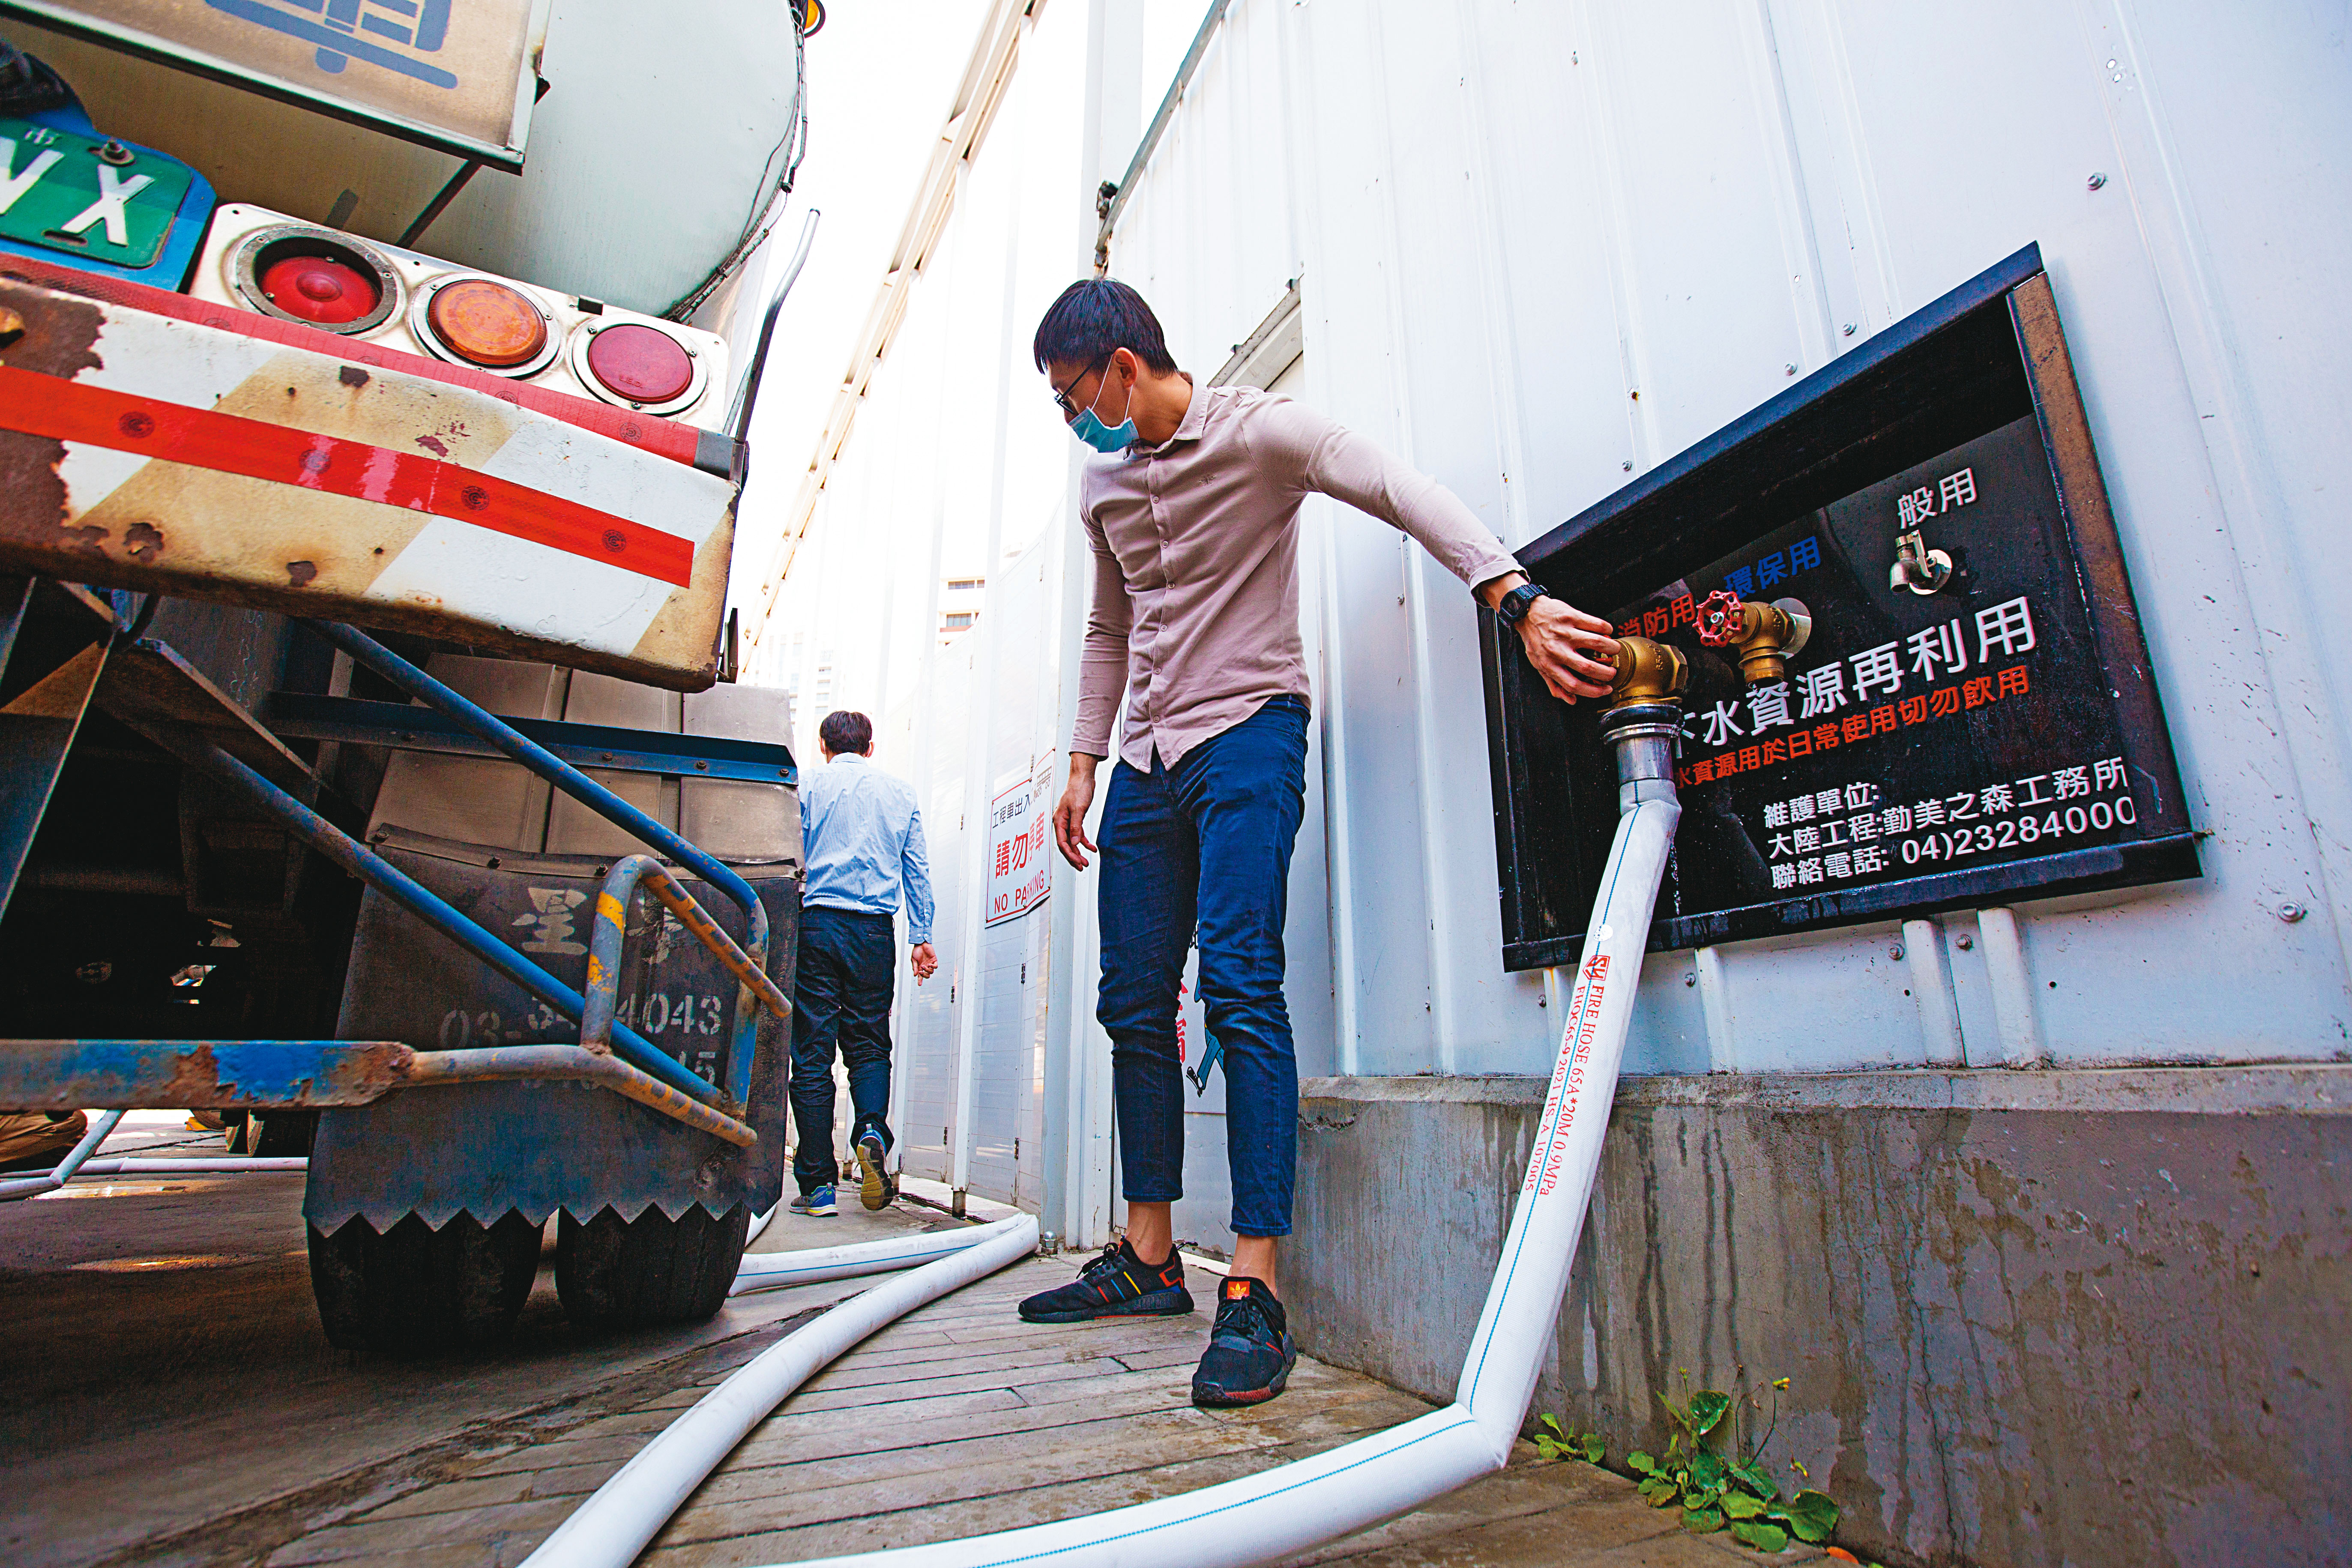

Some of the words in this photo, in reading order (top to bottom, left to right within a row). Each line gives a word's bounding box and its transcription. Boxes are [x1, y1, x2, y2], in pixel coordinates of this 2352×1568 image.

[619, 374, 642, 388] L.E.D.
[1897, 467, 1977, 529] 般用
[1724, 536, 1821, 600] 環保用
[1618, 593, 1696, 639] 消防用
[1763, 781, 1879, 829] 維護單位:
[995, 811, 1045, 879] 請勿停車
[1771, 845, 1889, 889] 聯絡電話:
[1902, 797, 2137, 864] 04)23284000
[994, 893, 1008, 914] NO
[1015, 870, 1044, 907] PARKING
[1562, 985, 1586, 1055] FHQC65-9
[1586, 984, 1604, 1018] FIRE
[1575, 1022, 1596, 1064] HOSE
[1553, 1059, 1567, 1089] 2021
[1541, 1096, 1559, 1134] HS-A
[1526, 1141, 1546, 1191] 107005
[1540, 1141, 1566, 1195] 0.9MPa
